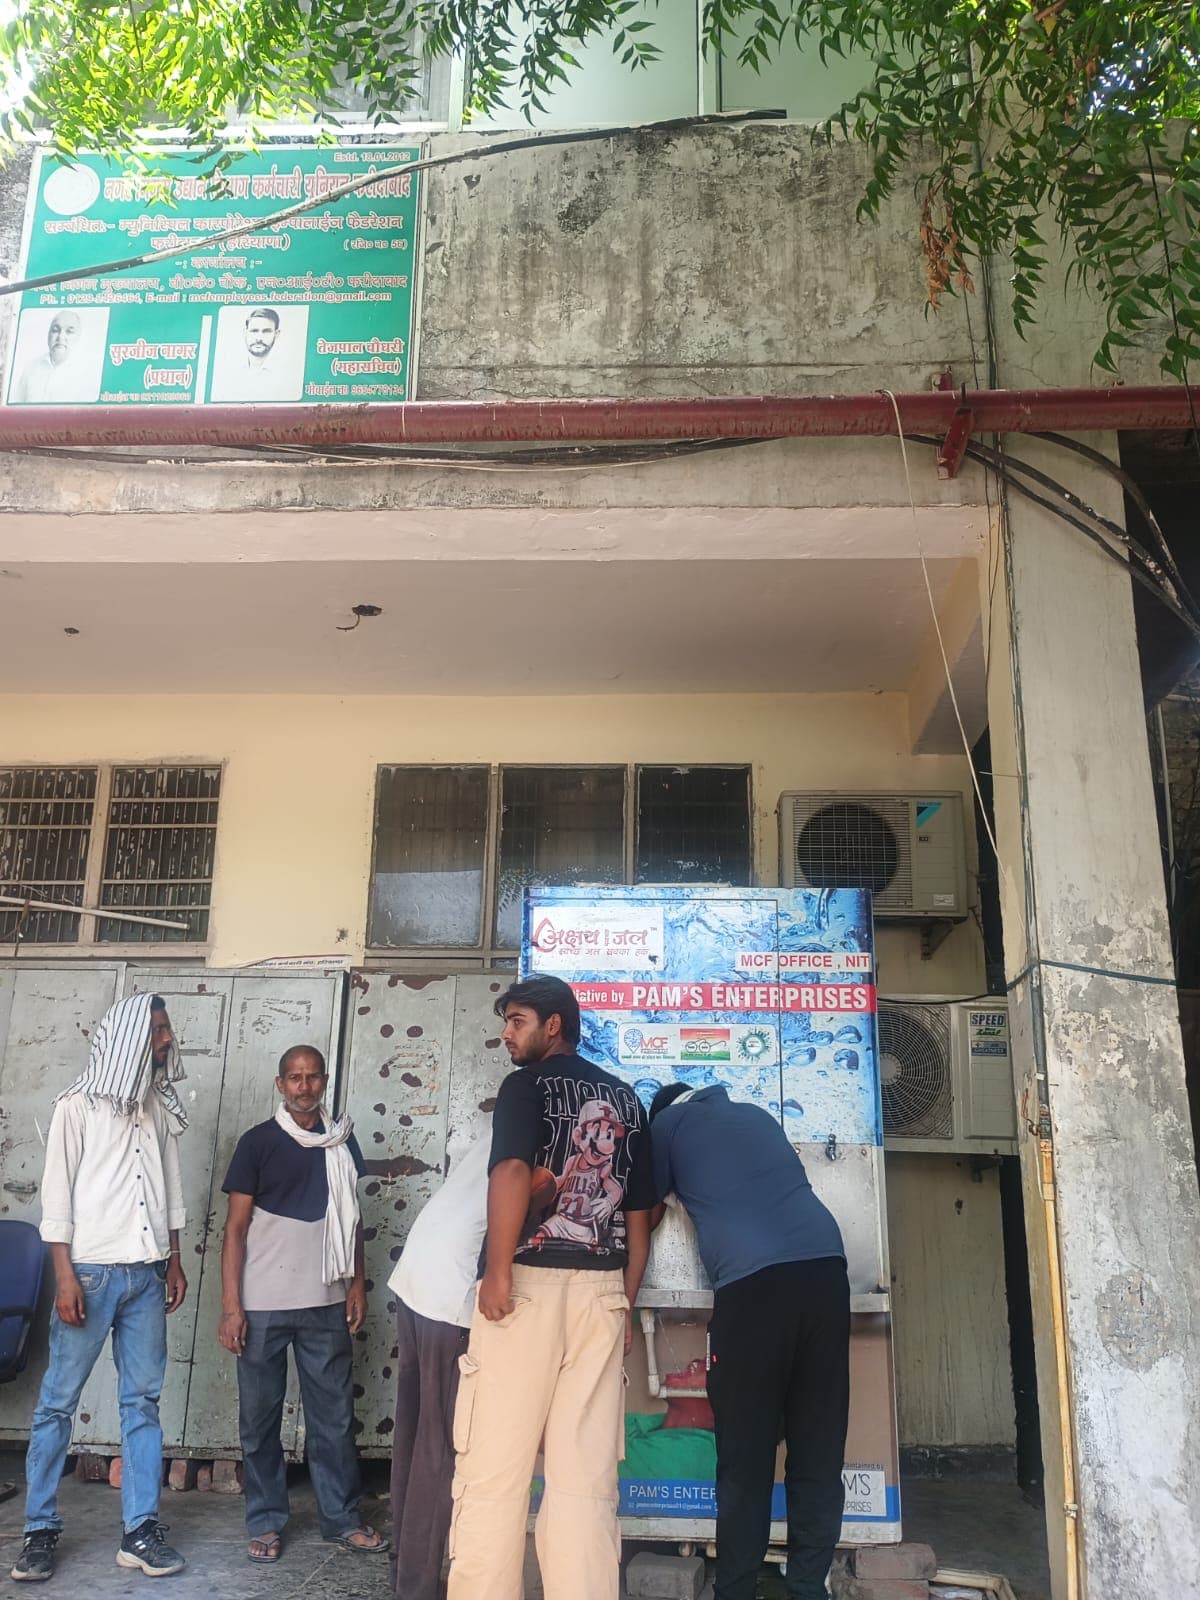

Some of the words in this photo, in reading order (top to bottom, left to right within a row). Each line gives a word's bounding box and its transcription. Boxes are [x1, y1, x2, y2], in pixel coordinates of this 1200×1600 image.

[252, 165, 302, 199] कर्मचारी
[160, 343, 197, 360] नागर
[317, 337, 364, 354] तेजपाल
[741, 954, 772, 967] MCF
[779, 955, 832, 967] OFFICE
[846, 956, 869, 967] NIT
[611, 989, 625, 1006] by
[632, 986, 703, 1007] PAM'S
[712, 986, 867, 1009] ENTERPRISES
[971, 1014, 1005, 1026] SPEED
[536, 1076, 641, 1129] HICAG
[629, 1485, 669, 1498] PAM'S
[843, 1472, 871, 1496] M'S
